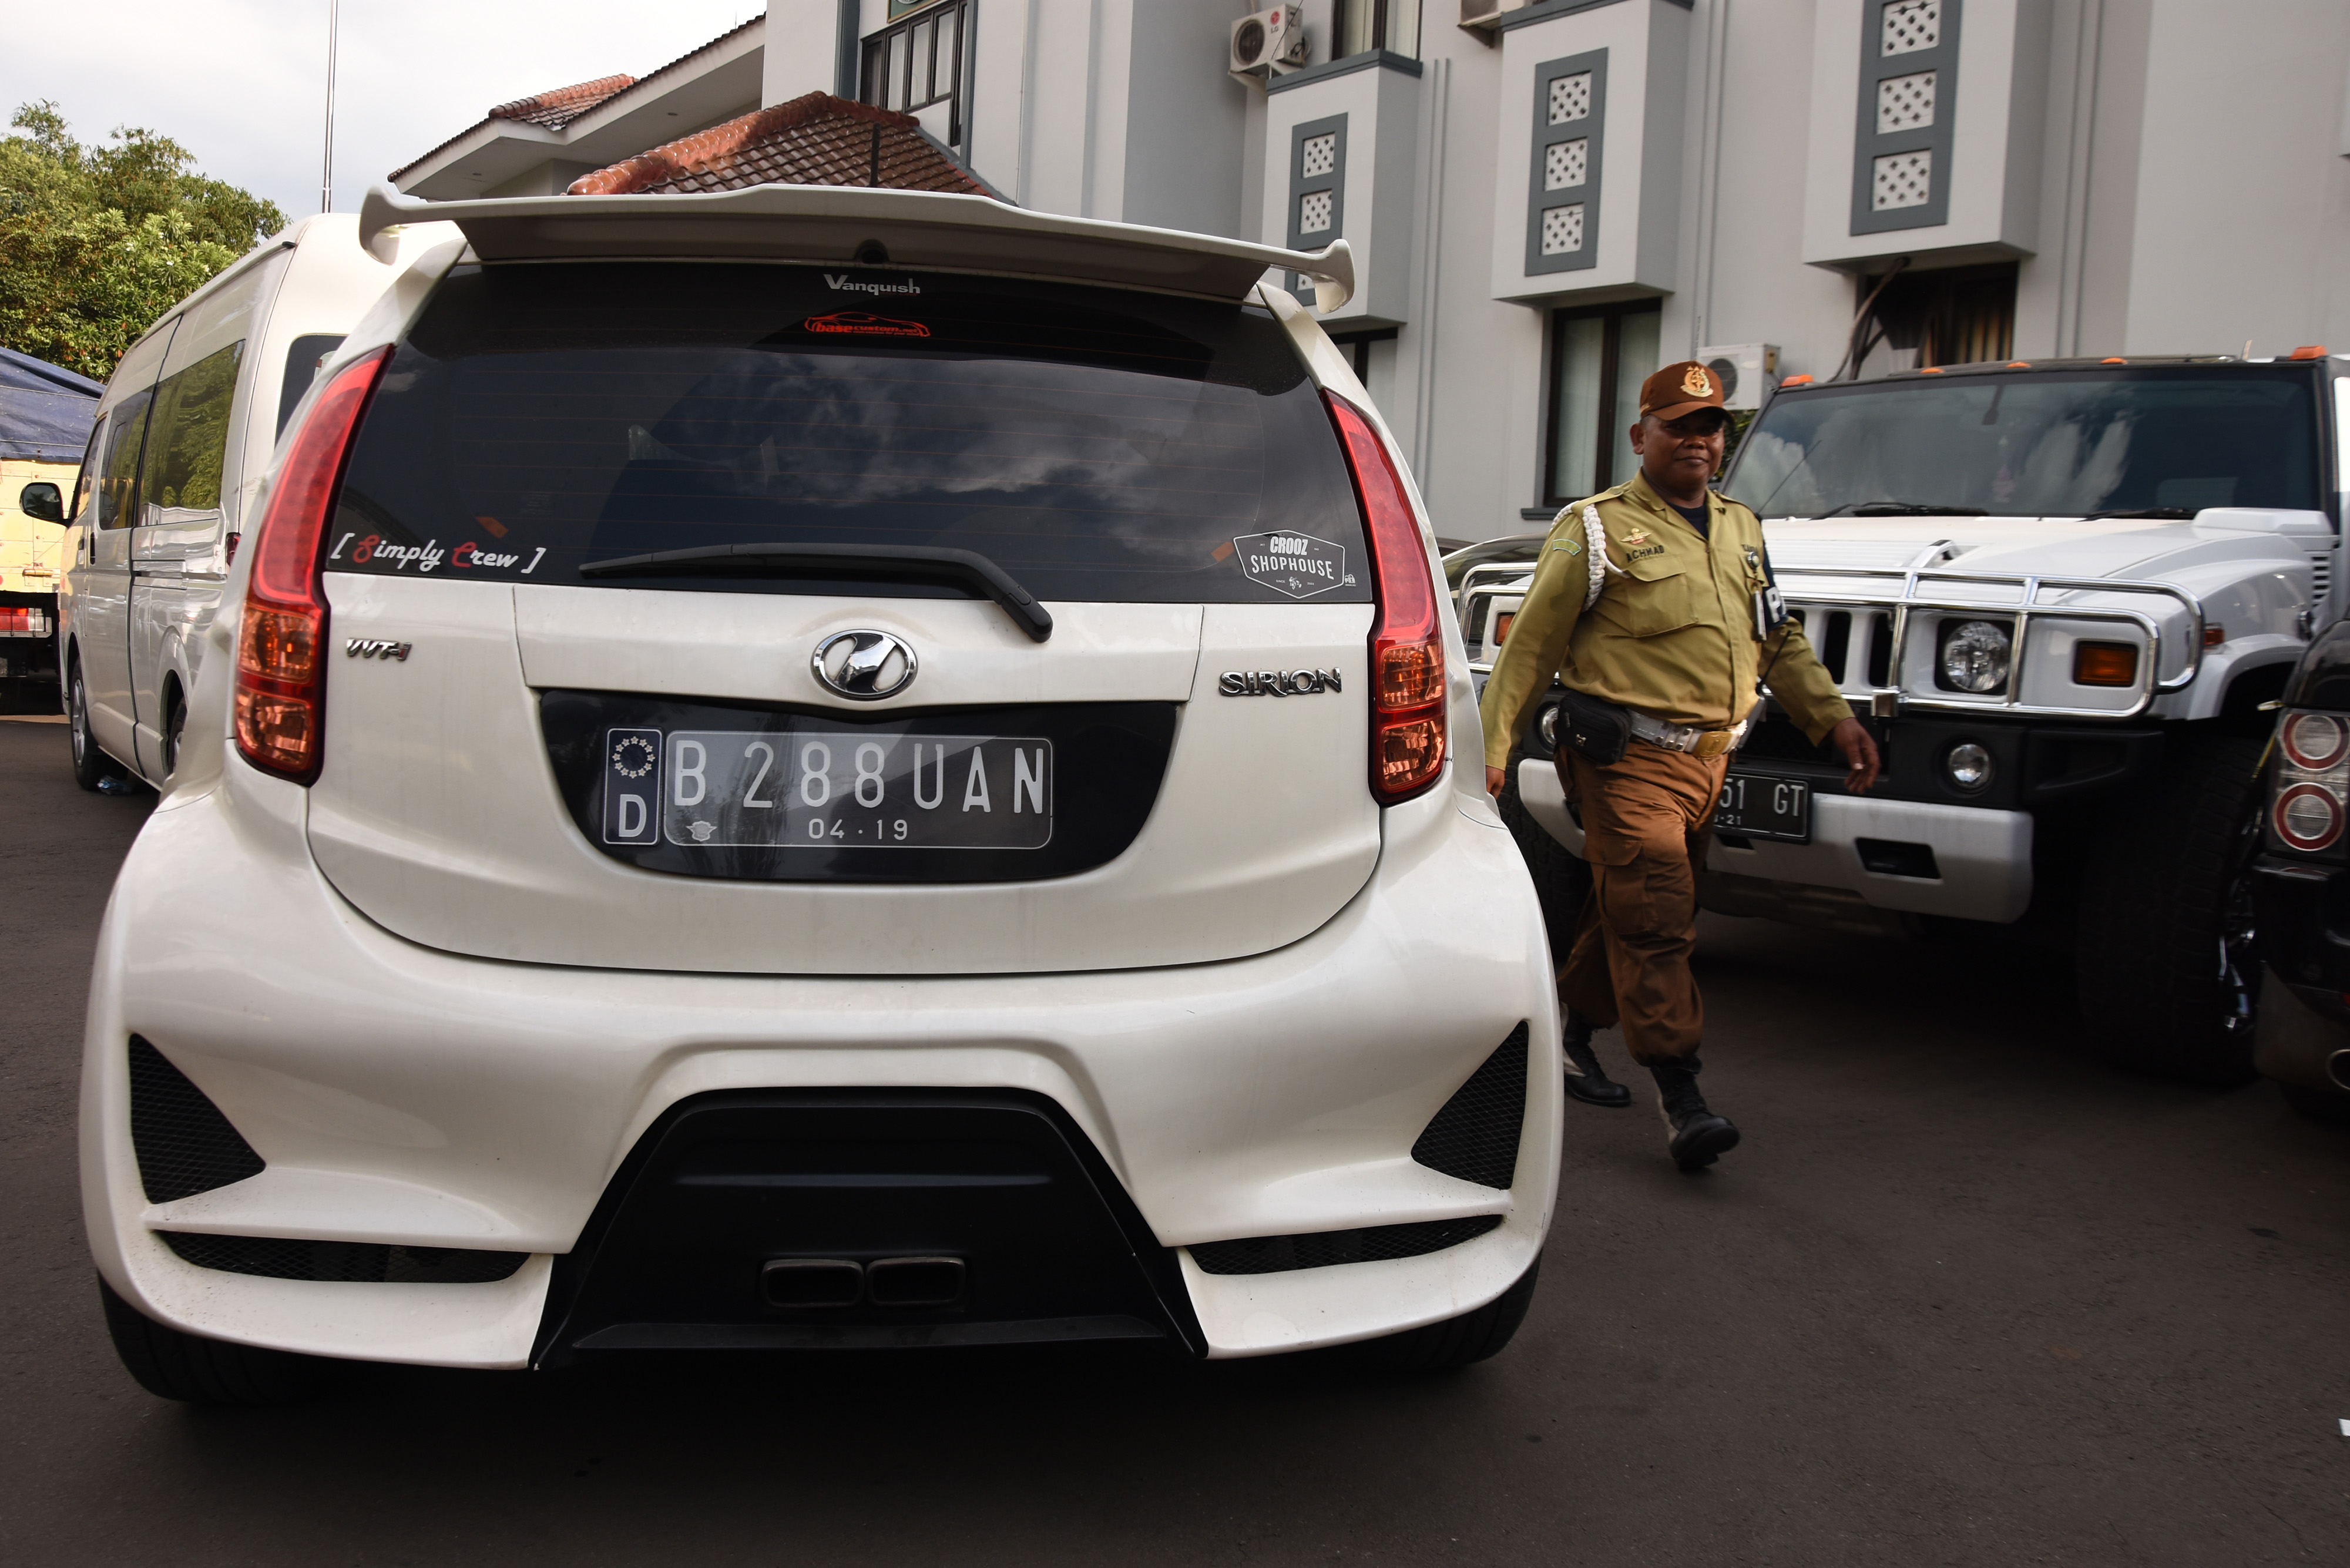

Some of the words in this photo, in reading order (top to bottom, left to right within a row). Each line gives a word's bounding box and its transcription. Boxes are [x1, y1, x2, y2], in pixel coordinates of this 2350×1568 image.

[824, 274, 920, 296] Vanquish
[353, 535, 445, 572] Simply
[451, 542, 519, 568] Crew
[1270, 536, 1308, 555] CROOZ
[1626, 545, 1664, 563] ACHMAD
[1250, 555, 1335, 580] SHOPHOUSE
[1218, 667, 1342, 697] SIRION
[674, 740, 706, 806] B
[743, 741, 885, 809] 288
[914, 743, 1044, 814] UAN
[1774, 784, 1805, 817] GT
[618, 794, 647, 838] D
